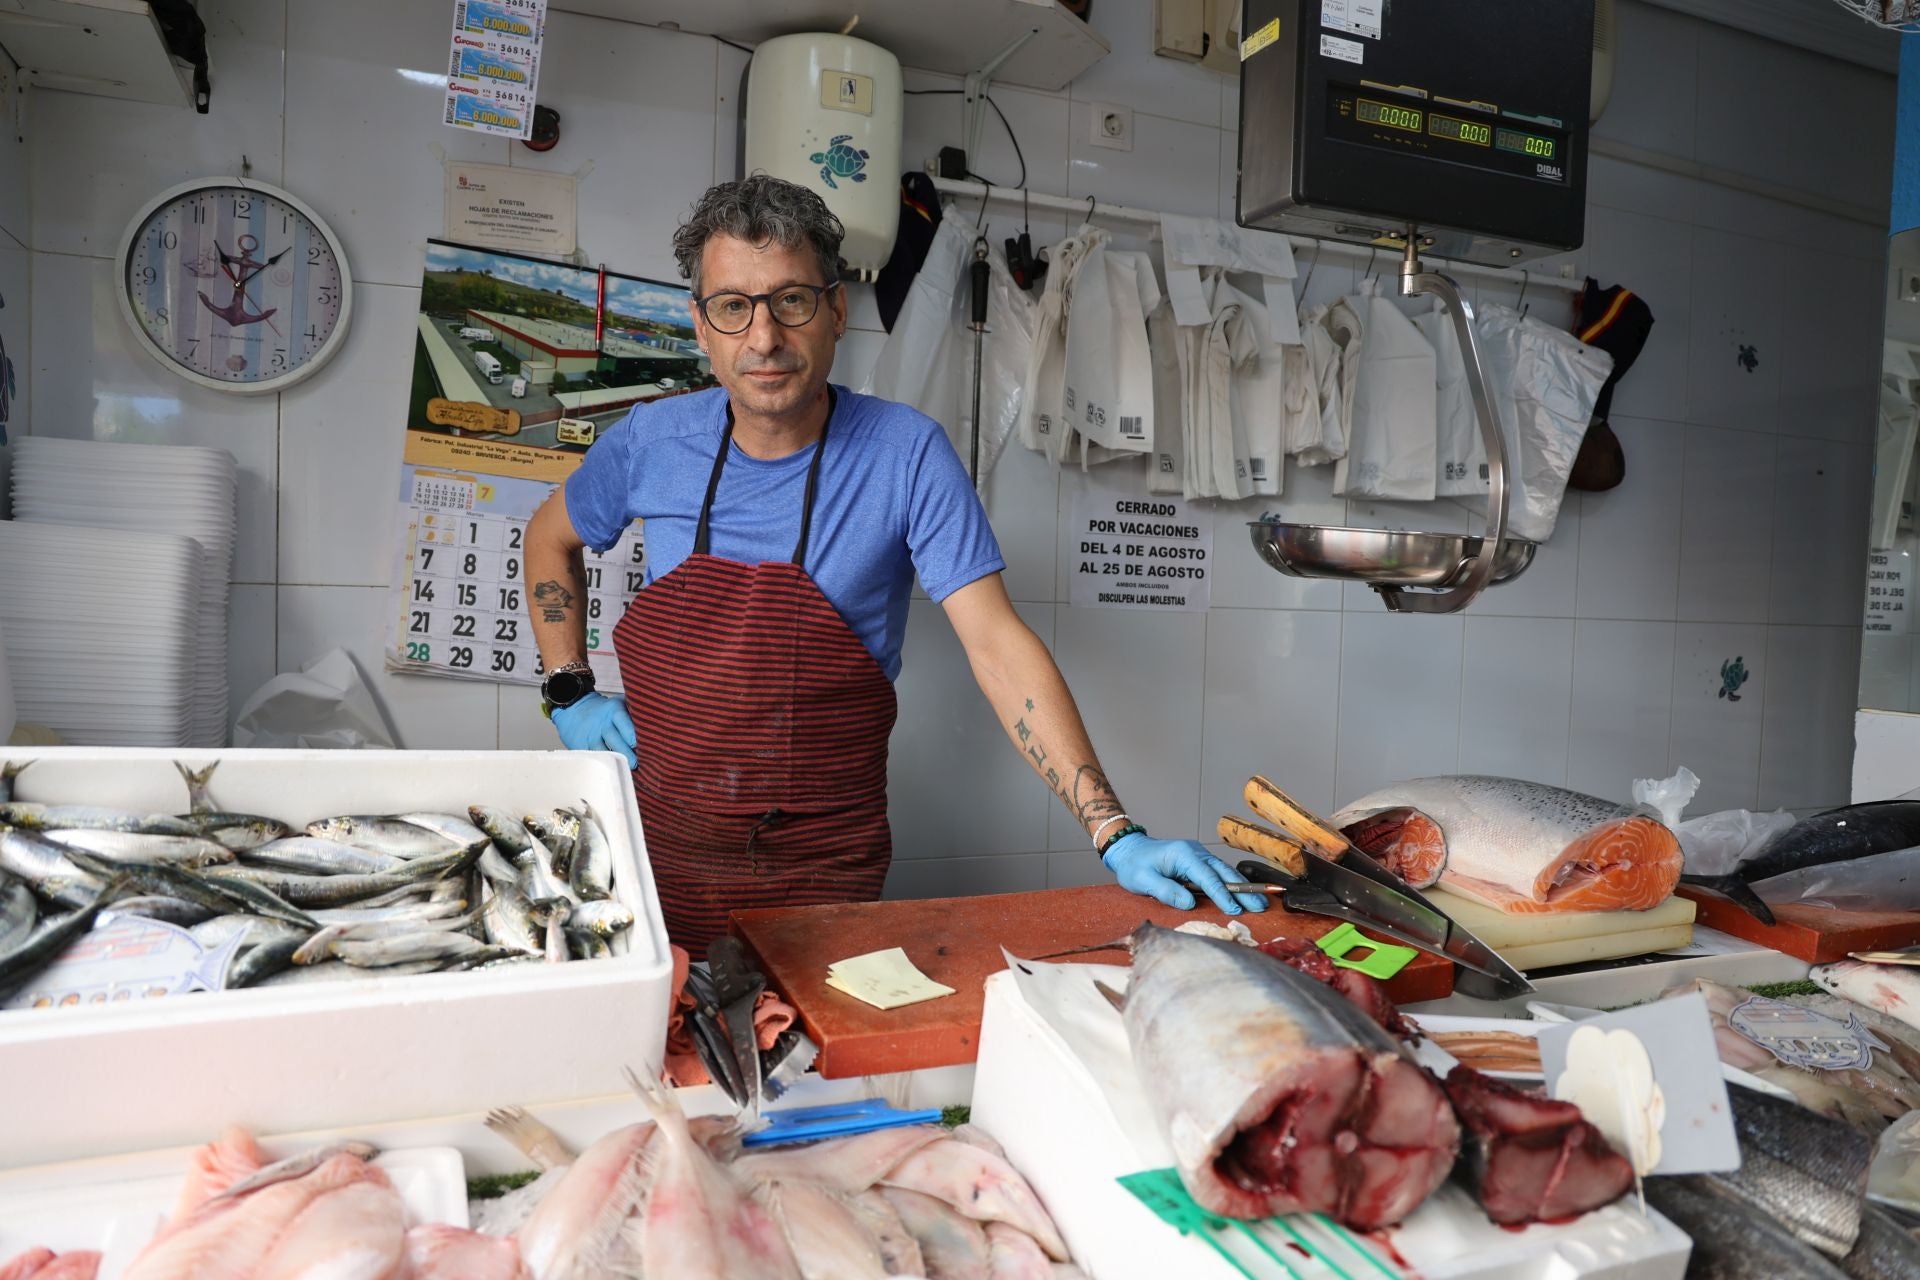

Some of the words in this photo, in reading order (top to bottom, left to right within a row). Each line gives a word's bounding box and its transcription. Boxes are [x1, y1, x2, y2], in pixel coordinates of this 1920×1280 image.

[500, 44, 531, 57] 56814
[495, 90, 526, 102] 56814
[1380, 106, 1420, 129] 0.000
[1460, 123, 1489, 143] 0.00
[1525, 137, 1553, 157] 0.00
[1537, 163, 1562, 177] DIBAL
[233, 200, 251, 220] 12
[498, 199, 525, 207] EXISTEN
[194, 205, 205, 225] 11
[501, 208, 554, 220] RECLAMACIONES
[282, 215, 287, 234] 1
[158, 230, 177, 250] 10
[307, 248, 321, 266] 2
[142, 266, 157, 286] 9
[318, 286, 331, 305] 3
[155, 307, 169, 326] 8
[304, 324, 317, 341] 4
[187, 338, 201, 357] 7
[271, 348, 286, 367] 5
[475, 451, 506, 460] BRIVIESCA
[481, 487, 490, 499] 7
[424, 504, 440, 512] Lunes
[1116, 500, 1176, 516] CERRADO
[1089, 519, 1116, 533] POR
[1119, 521, 1199, 539] VACACIONES
[470, 522, 478, 544] 1
[509, 527, 522, 549] 2
[632, 543, 644, 563] 5
[1080, 542, 1108, 555] DEL
[1112, 543, 1122, 555] 4
[1126, 544, 1144, 557] DE
[1148, 546, 1206, 560] AGOSTO
[421, 548, 434, 570] 7
[463, 553, 477, 575] 8
[506, 558, 519, 580] 9
[626, 571, 644, 593] 12
[1079, 561, 1098, 574] AL
[1102, 562, 1120, 575] 25
[1125, 564, 1143, 576] DE
[1147, 565, 1205, 580] AGOSTO
[1116, 581, 1137, 589] AMBOS
[1138, 582, 1169, 590] INCLUIDOS
[413, 579, 435, 602] 14
[457, 584, 477, 606] 15
[499, 588, 520, 611] 16
[588, 598, 602, 619] 8
[1098, 592, 1135, 604] DISCULPEN
[1136, 594, 1149, 604] LAS
[1149, 595, 1186, 606] MOLESTIAS
[410, 610, 430, 633] 21
[452, 614, 476, 638] 22
[495, 618, 518, 642] 23
[406, 641, 430, 663] 28
[449, 646, 473, 668] 29
[491, 650, 516, 673] 30
